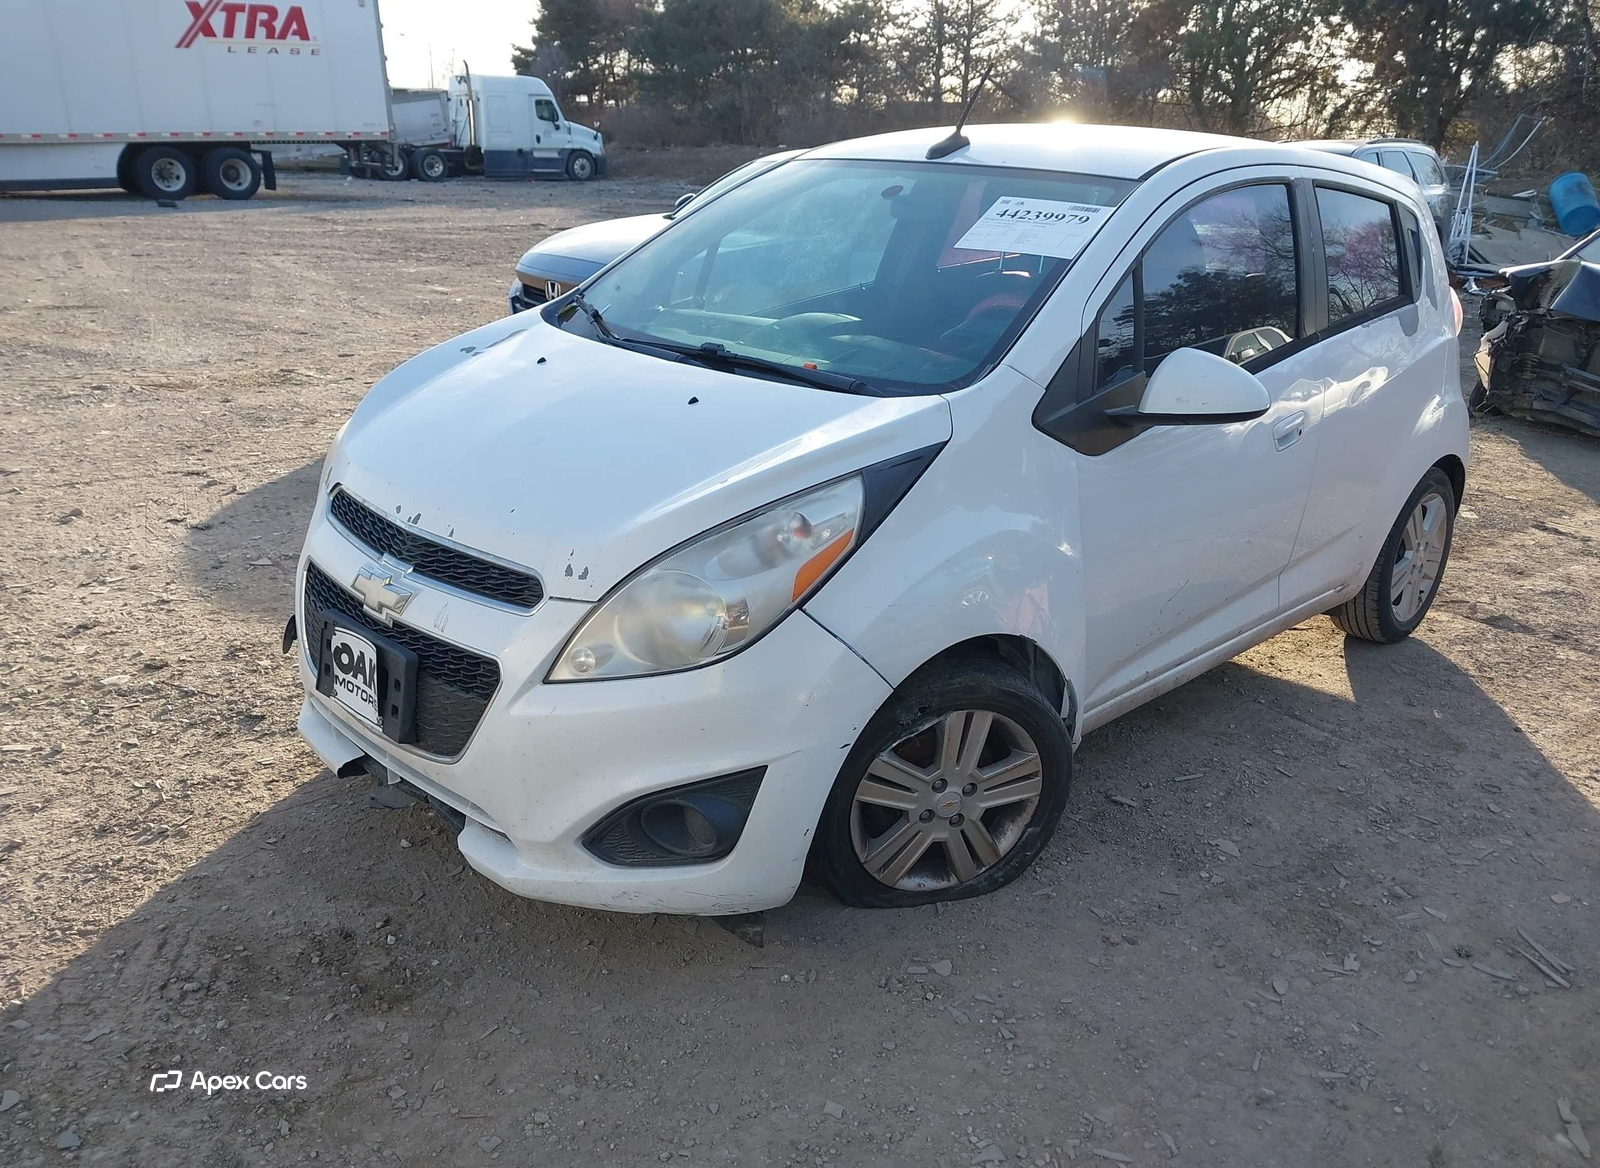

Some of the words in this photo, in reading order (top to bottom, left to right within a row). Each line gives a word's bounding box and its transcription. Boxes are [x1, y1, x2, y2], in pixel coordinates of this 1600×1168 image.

[175, 0, 310, 48] XTRA
[227, 46, 321, 56] LEASE
[996, 208, 1091, 226] 44239979
[333, 642, 377, 695] OAK
